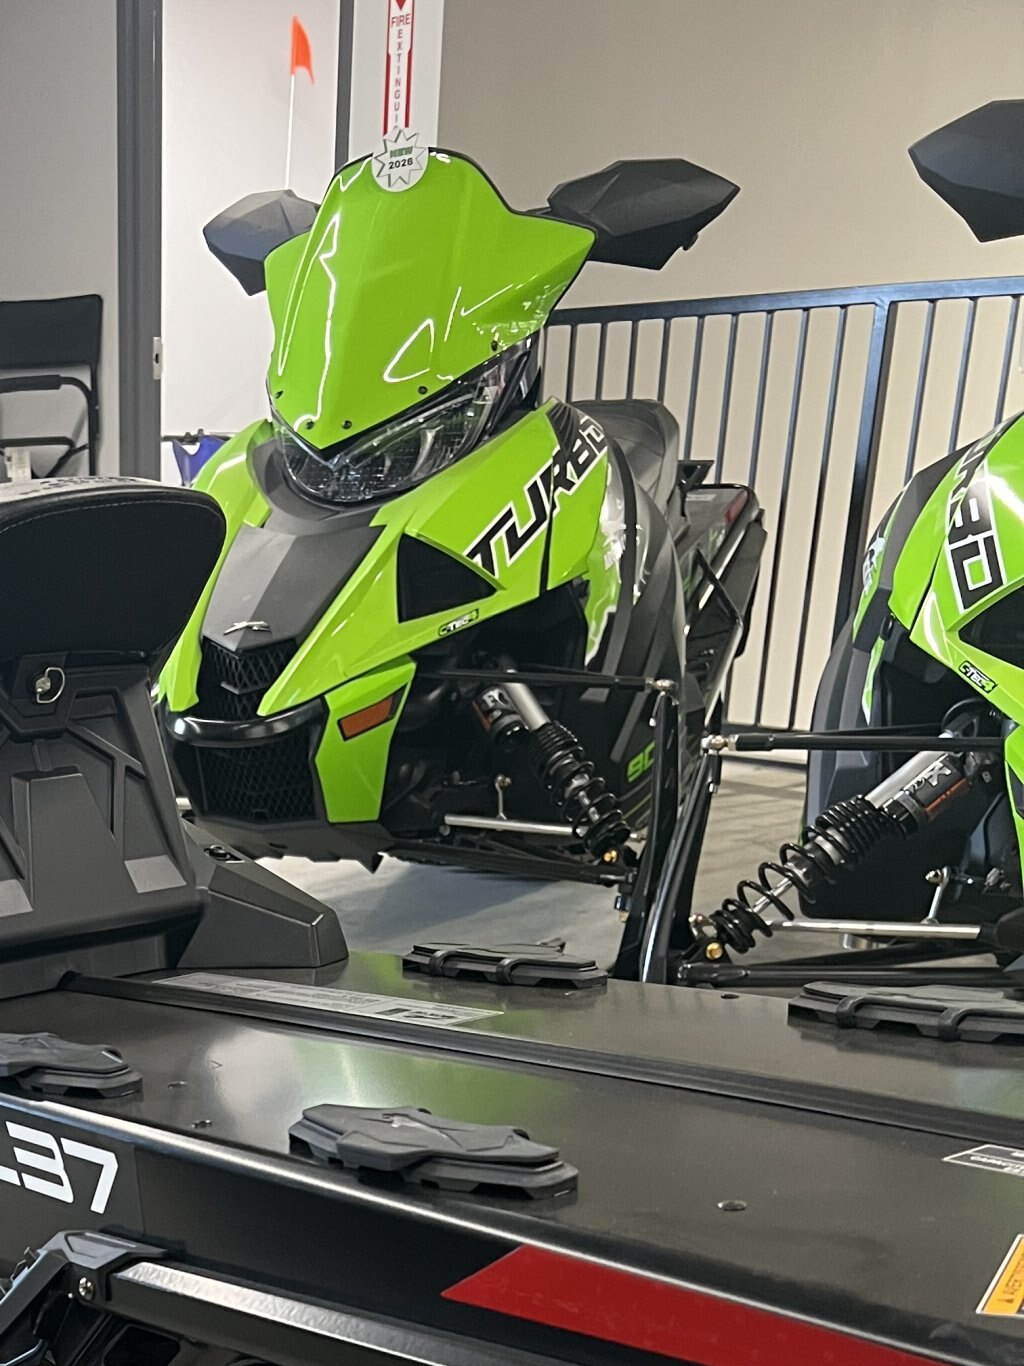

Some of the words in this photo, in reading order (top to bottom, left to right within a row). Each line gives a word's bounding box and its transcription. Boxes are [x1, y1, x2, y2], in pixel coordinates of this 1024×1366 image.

[391, 13, 411, 28] FIRE
[393, 28, 403, 130] EXTINGUI
[388, 158, 413, 170] 2026
